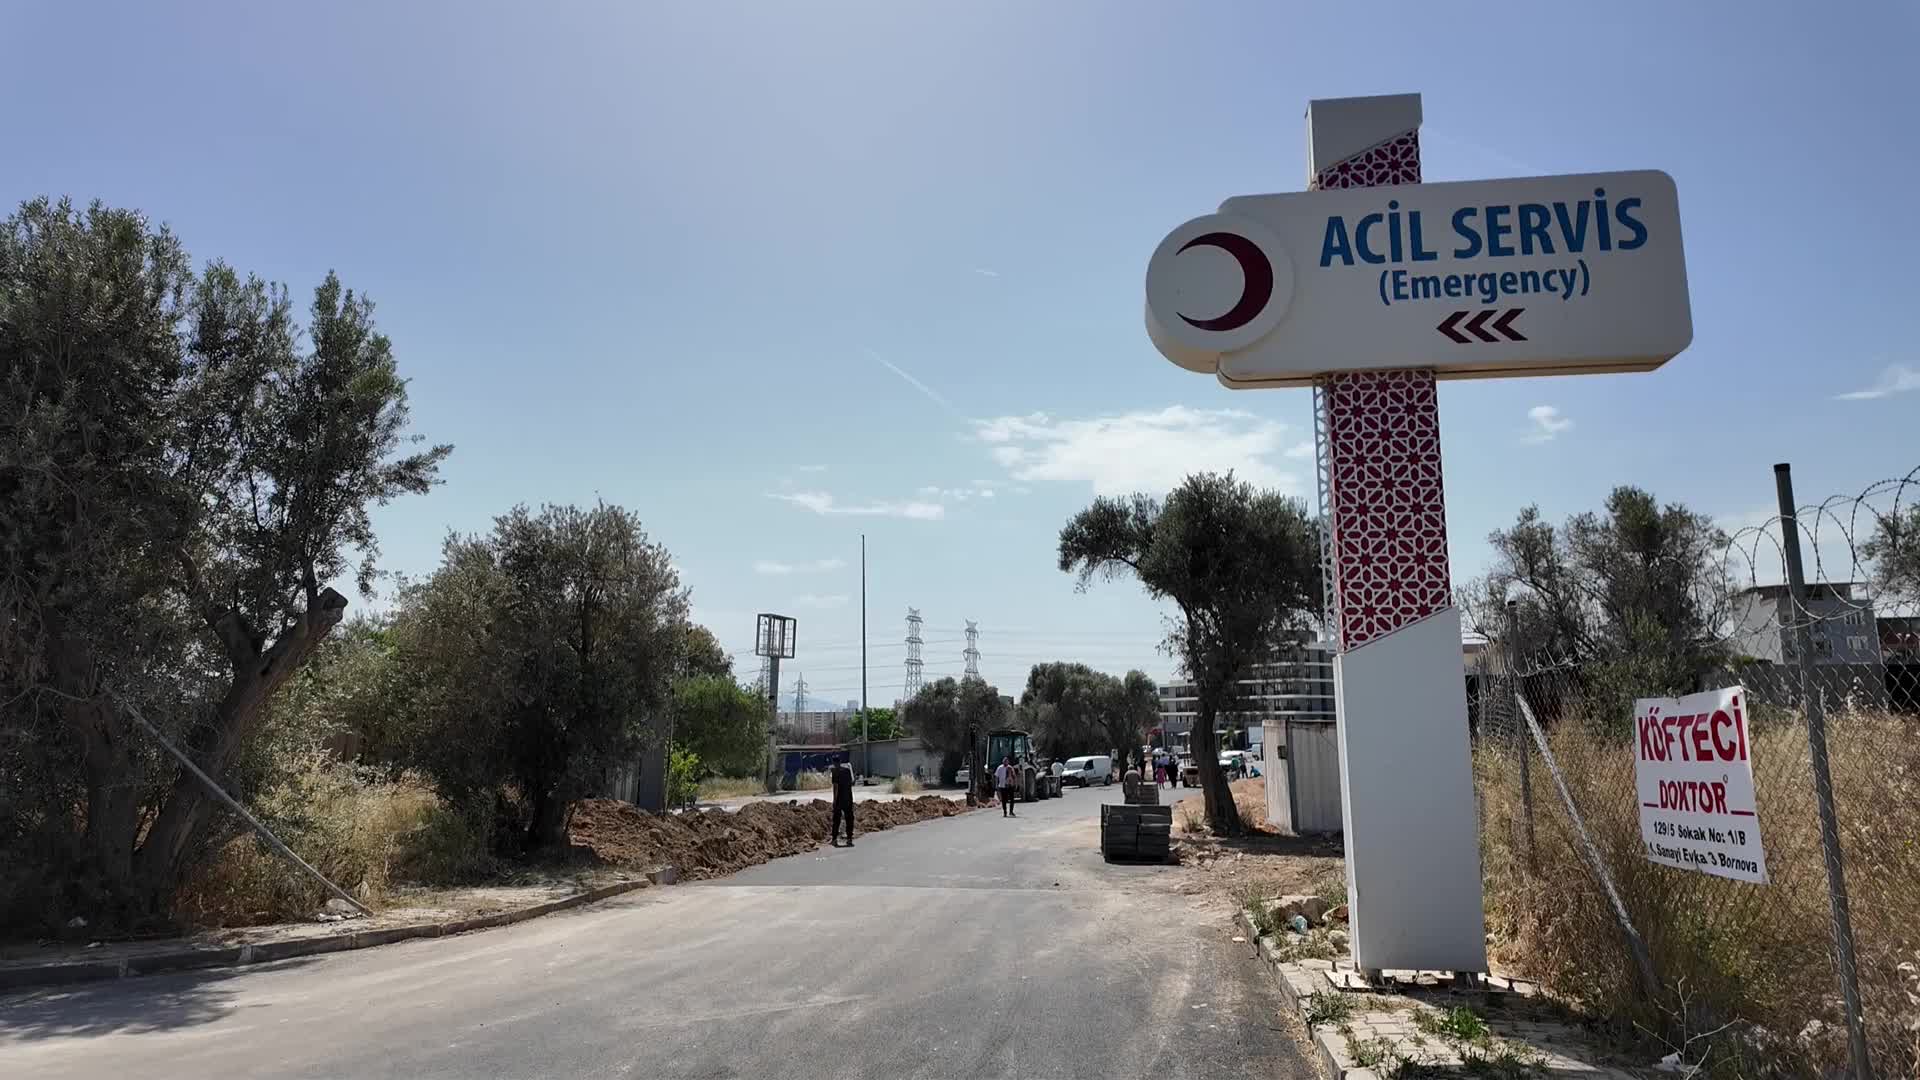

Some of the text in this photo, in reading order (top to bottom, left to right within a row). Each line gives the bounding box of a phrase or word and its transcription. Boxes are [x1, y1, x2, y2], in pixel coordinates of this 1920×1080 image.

[1320, 187, 1648, 267] ACİL SERVİS
[1379, 259, 1591, 306] (Emergency)
[1638, 695, 1747, 762] KÖFTECİ
[1653, 820, 1746, 846] 129/5 Sokak No: 1/B
[1656, 843, 1682, 864] Sanayi
[1683, 848, 1708, 865] Evka
[1708, 851, 1717, 866] 3
[1717, 853, 1758, 874] Bornova
